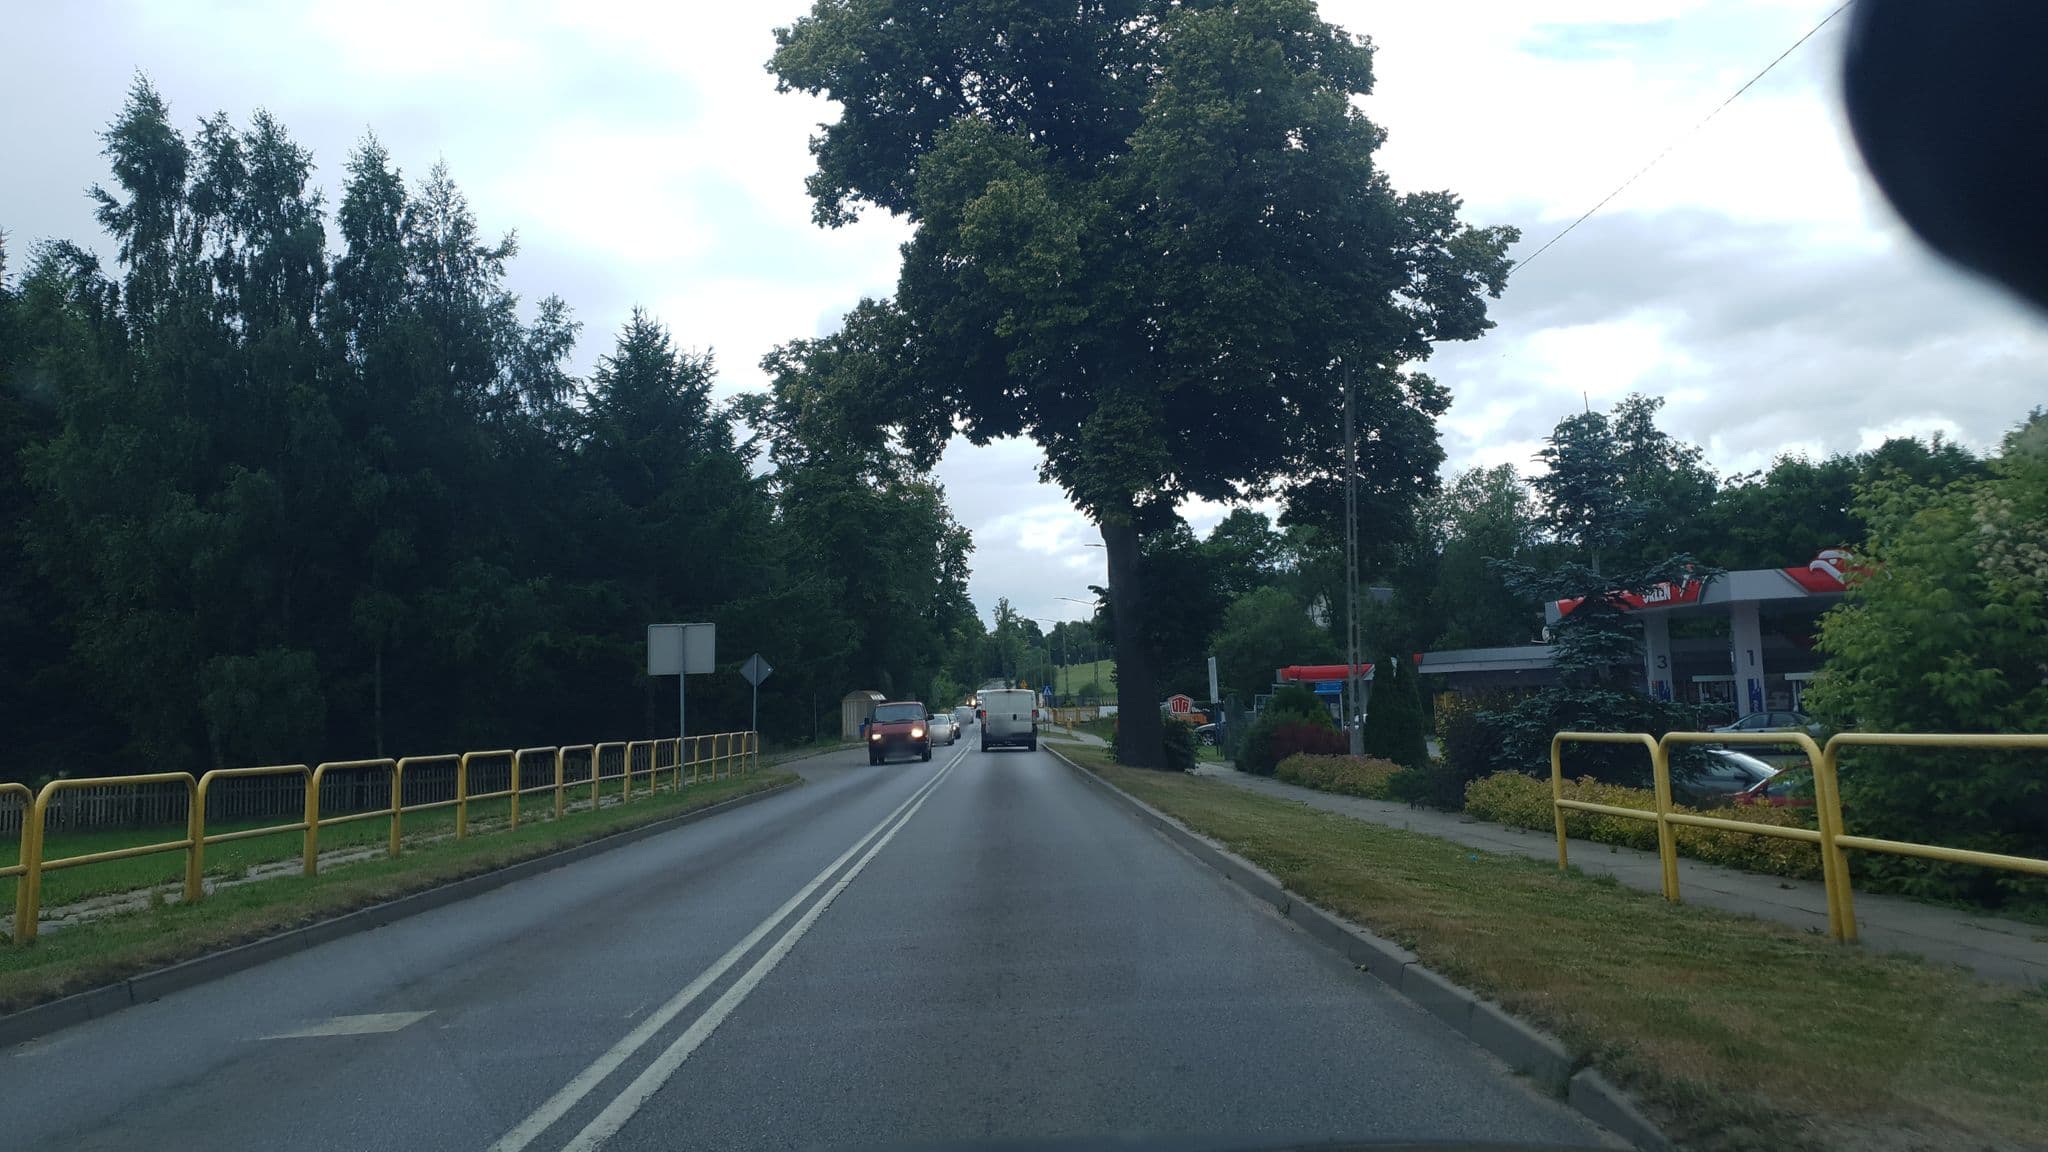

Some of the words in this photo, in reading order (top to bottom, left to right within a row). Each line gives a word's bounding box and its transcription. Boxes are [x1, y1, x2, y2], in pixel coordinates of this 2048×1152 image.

[1657, 655, 1668, 669] 3
[1746, 650, 1755, 666] 1
[1172, 696, 1190, 713] UTA
